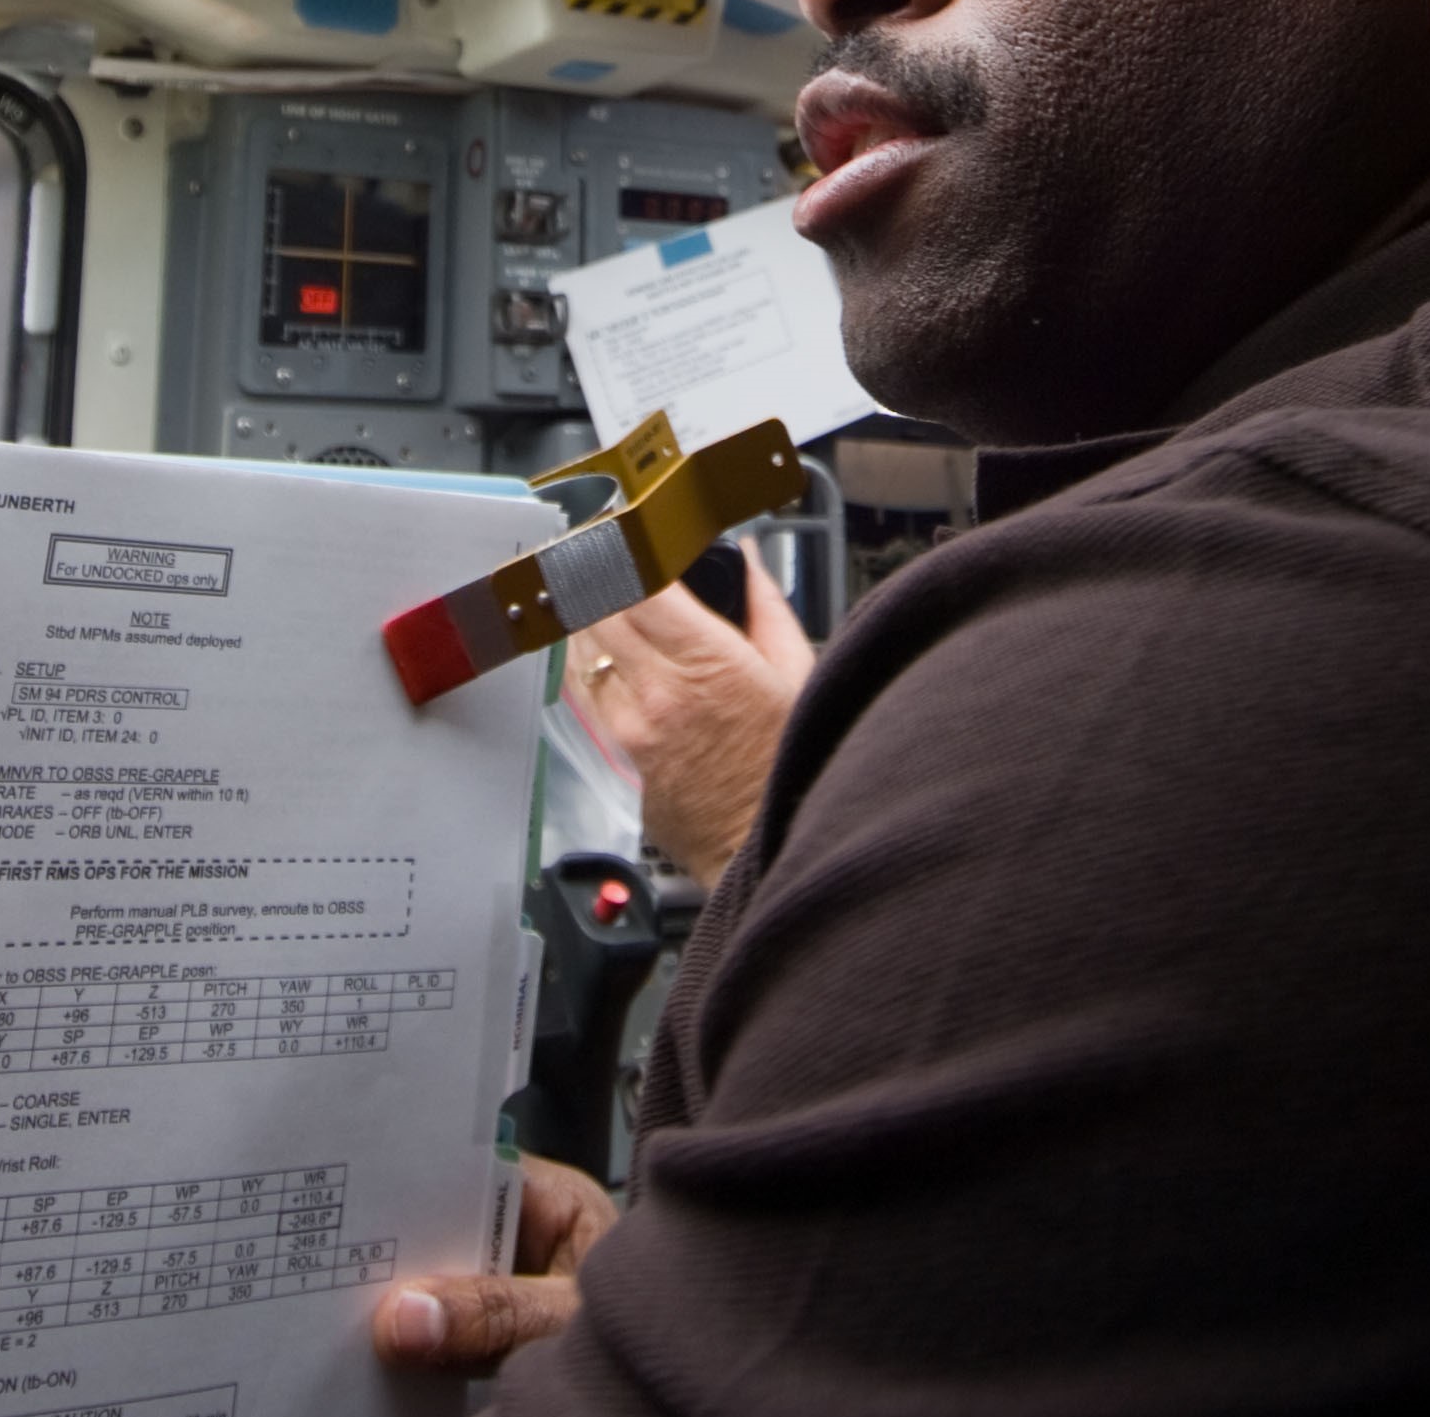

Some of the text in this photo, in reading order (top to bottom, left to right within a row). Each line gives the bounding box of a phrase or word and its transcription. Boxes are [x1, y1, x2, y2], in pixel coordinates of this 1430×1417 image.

[107, 547, 177, 566] WARNING
[56, 562, 219, 588] For UNDOCKED ops only
[131, 611, 171, 627] NOTE
[45, 625, 241, 650] Stbd MPMs assumed deployed
[15, 662, 66, 677] SETUP
[19, 686, 181, 706] SM 94 PDRS CONTROL
[48, 766, 68, 781] TO
[72, 767, 115, 782] OBSS
[118, 768, 220, 783] PRE-GRAPPLE
[73, 788, 91, 800] as
[94, 788, 124, 803] reqd
[128, 786, 173, 802] (VERN
[177, 787, 214, 801] within
[219, 788, 233, 801] 10
[235, 788, 250, 802] ft)
[71, 806, 102, 819] OFF
[105, 806, 163, 822] (tb-OFF)
[69, 826, 104, 839] ORB
[106, 826, 140, 841] UNL,
[143, 826, 193, 839] ENTER
[46, 866, 81, 881] RMS
[84, 865, 116, 881] OPS
[120, 865, 151, 880] FOR
[155, 865, 186, 879] THE
[188, 865, 250, 879] MISSION
[70, 901, 365, 920] Perform manual PLB survey, enroute to OBSS
[75, 923, 236, 939] PRE-GRAPPLE position
[5, 970, 19, 983] to
[22, 967, 67, 982] OBSS
[70, 965, 179, 982] PRE-GRAPPLE
[181, 964, 217, 980] posn:
[203, 977, 378, 997] PITCH YAW ROLL
[12, 1092, 81, 1109] COARSE
[9, 1113, 72, 1131] SINGLE,
[77, 1109, 131, 1126] ENTER
[28, 1155, 61, 1171] Roll:
[21, 1369, 77, 1393] (tb-ON)
